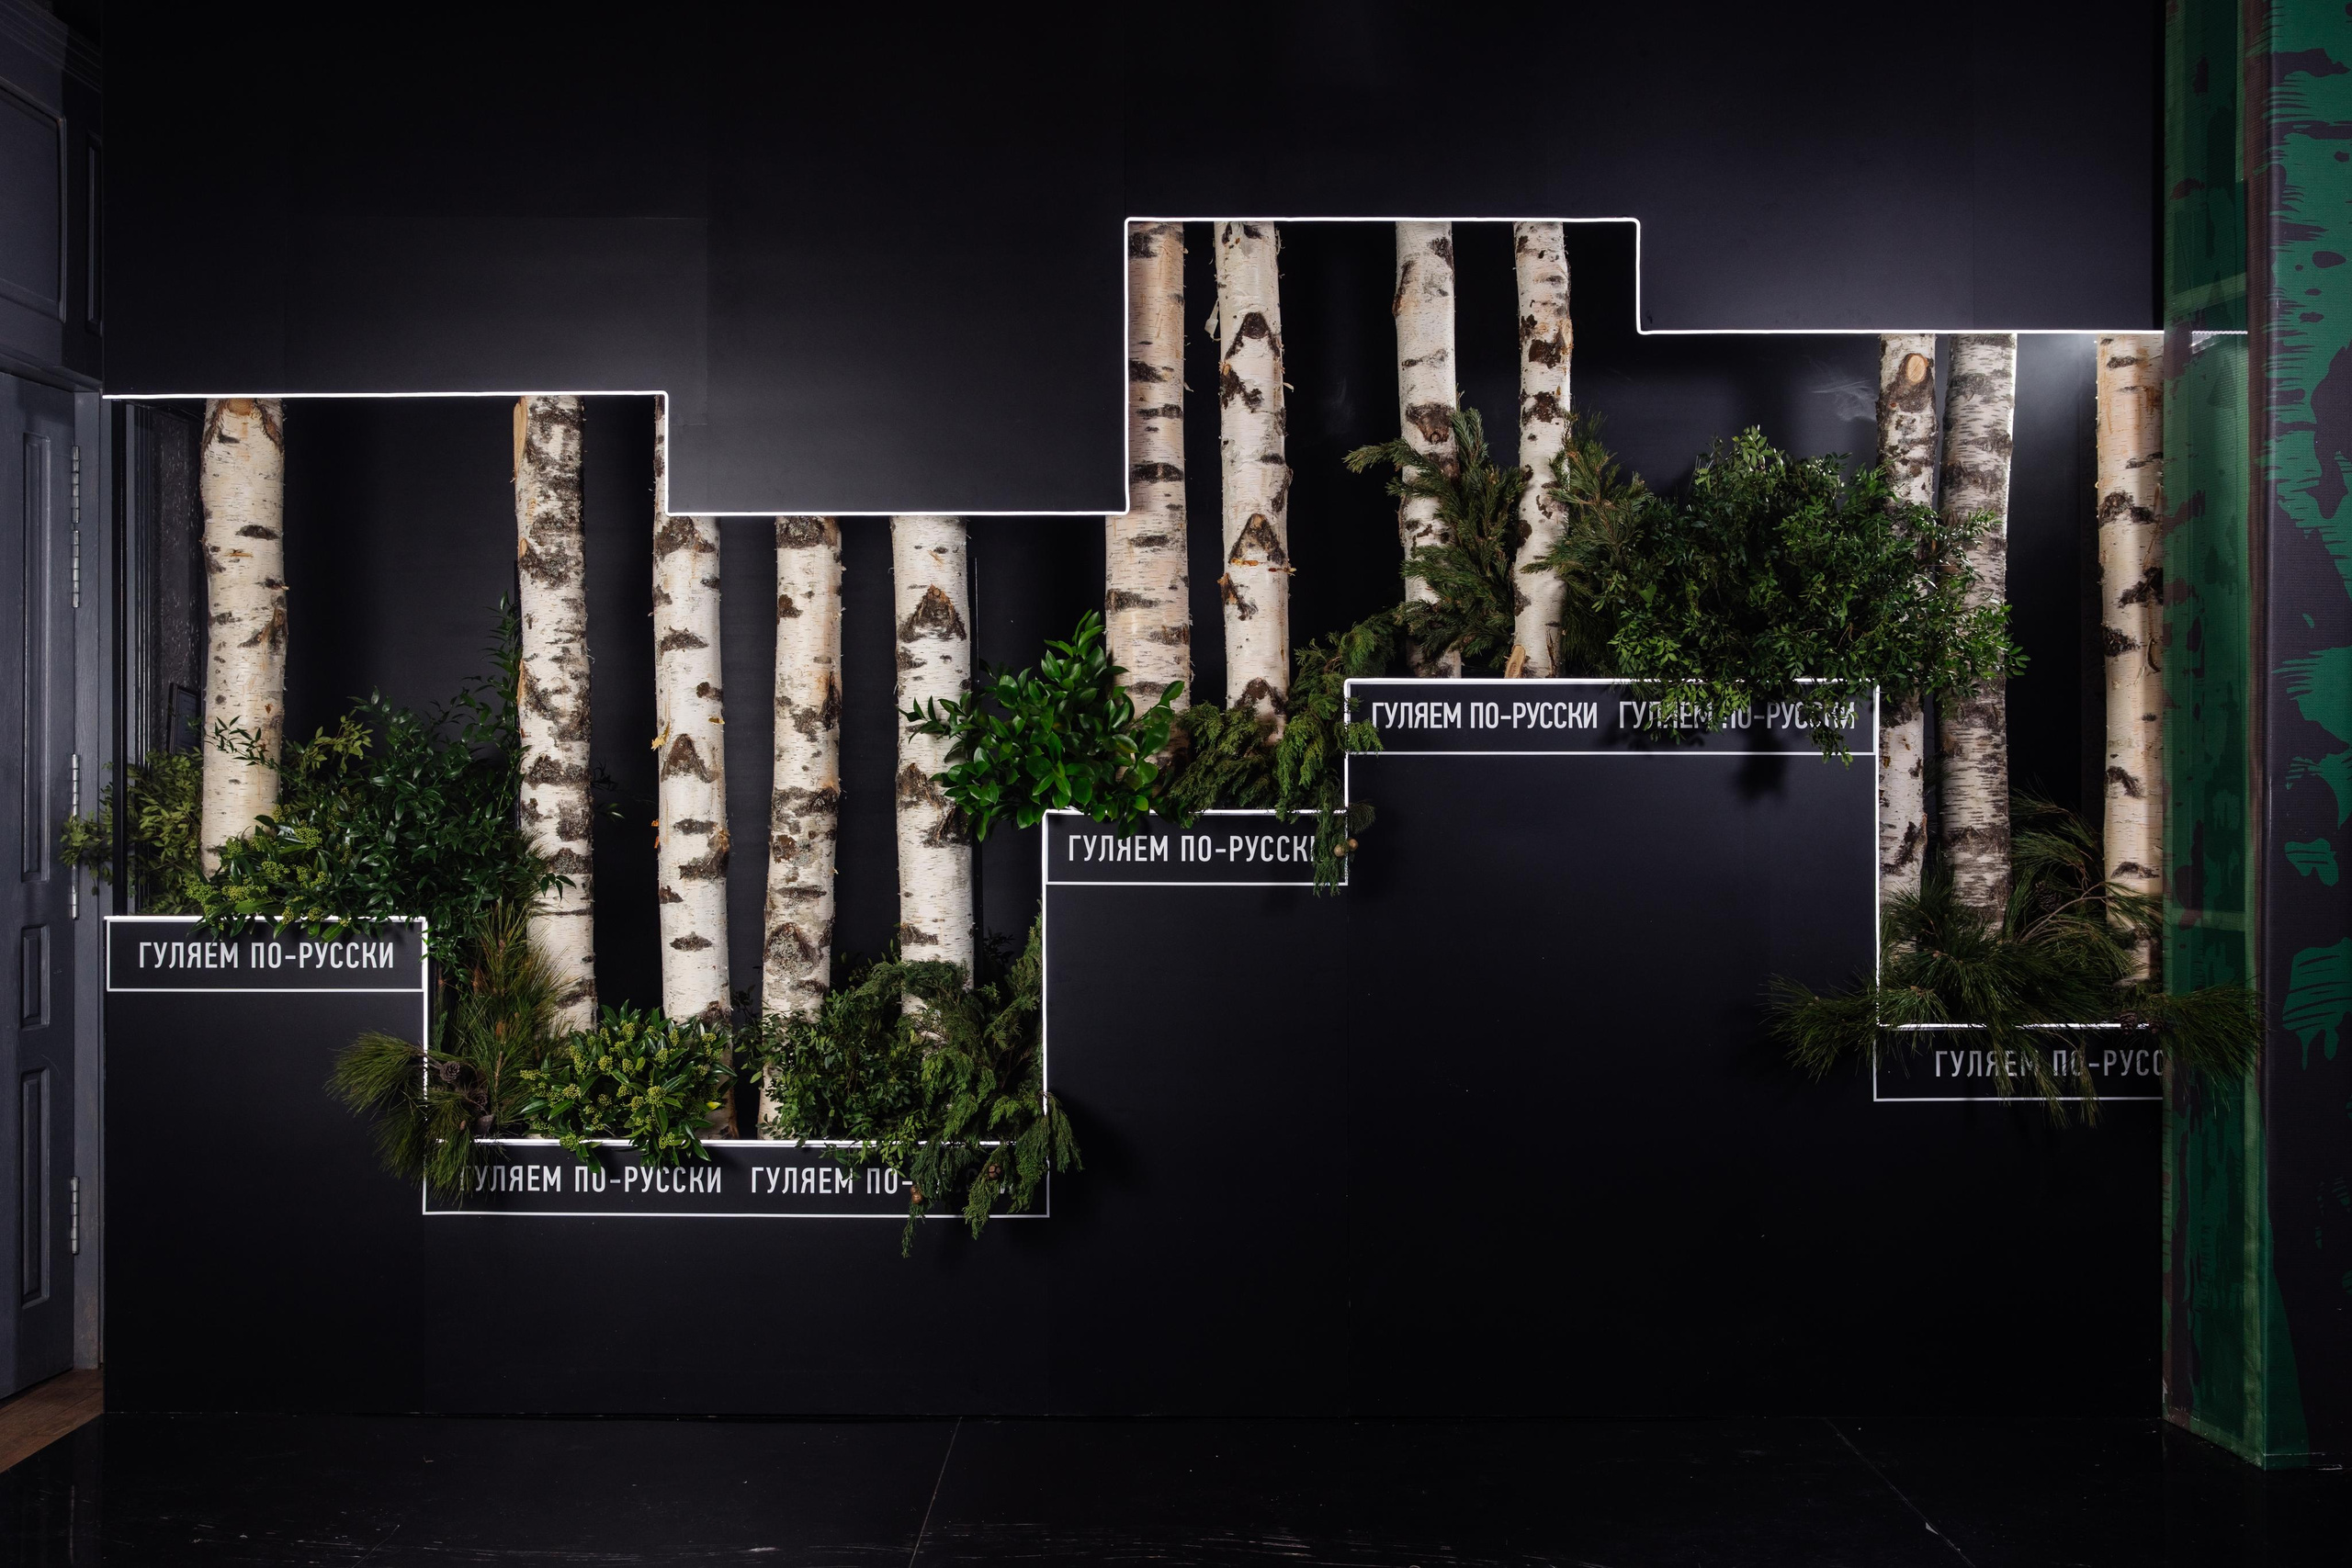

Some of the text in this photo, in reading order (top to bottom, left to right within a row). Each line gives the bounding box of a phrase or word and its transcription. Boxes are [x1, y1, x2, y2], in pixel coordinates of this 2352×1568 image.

[1372, 701, 1598, 729] ГУЛЯЕМ ПО-РУССКИ
[1069, 834, 1169, 863] ГУЛЯЕМ
[139, 942, 394, 969] ГУЛЯЕМ ПО-РУССКИ
[574, 1166, 721, 1193] ПО-РУССКИ
[751, 1167, 854, 1194] ГУЛЯЕМ
